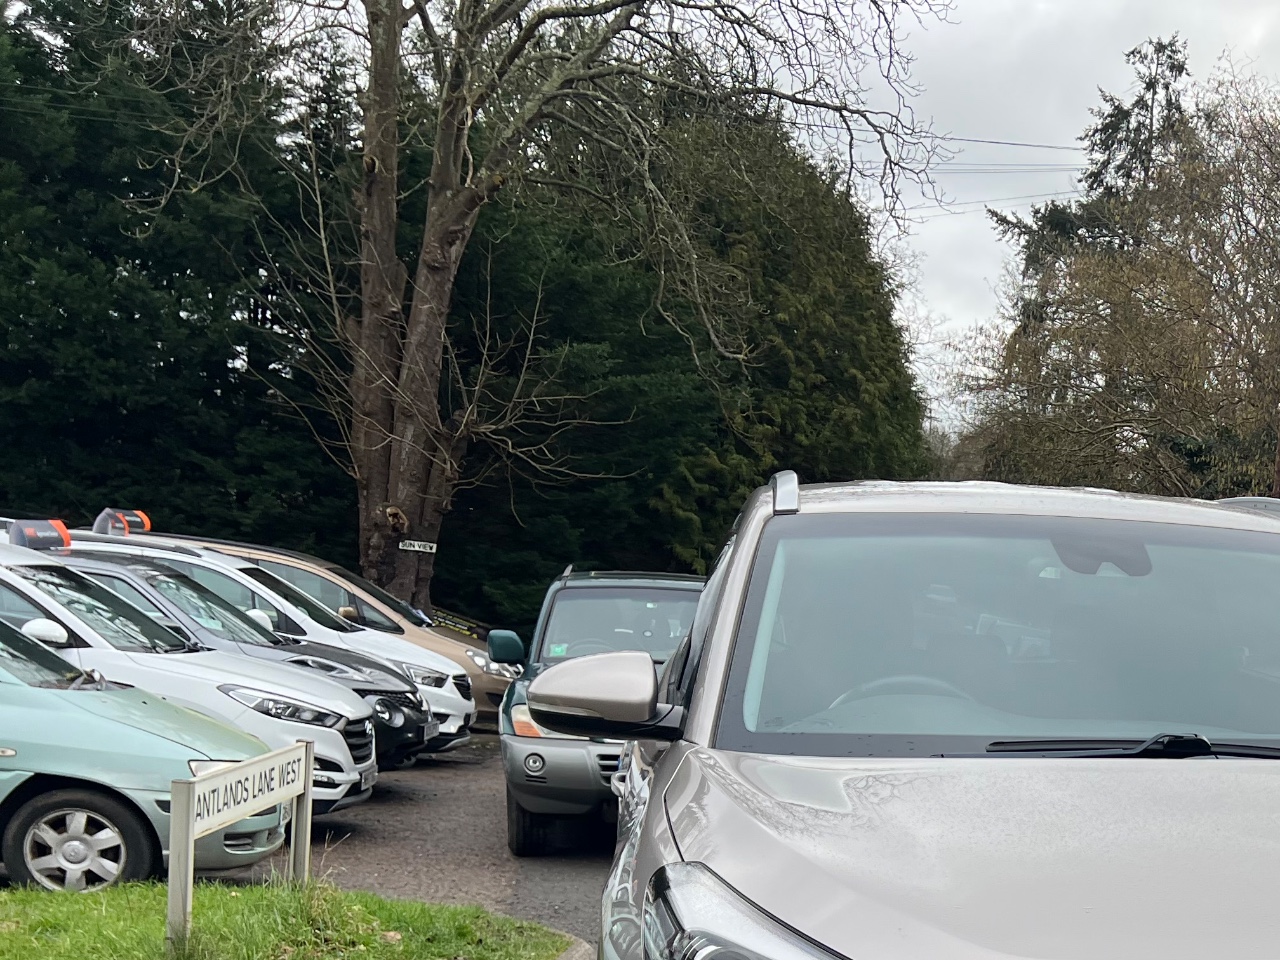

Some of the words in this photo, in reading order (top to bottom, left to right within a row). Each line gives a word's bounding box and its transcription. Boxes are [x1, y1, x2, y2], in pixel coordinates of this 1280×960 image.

[401, 541, 415, 549] SUN
[195, 777, 249, 821] ANTLANDS
[252, 767, 275, 799] LANE
[278, 758, 302, 788] WEST
